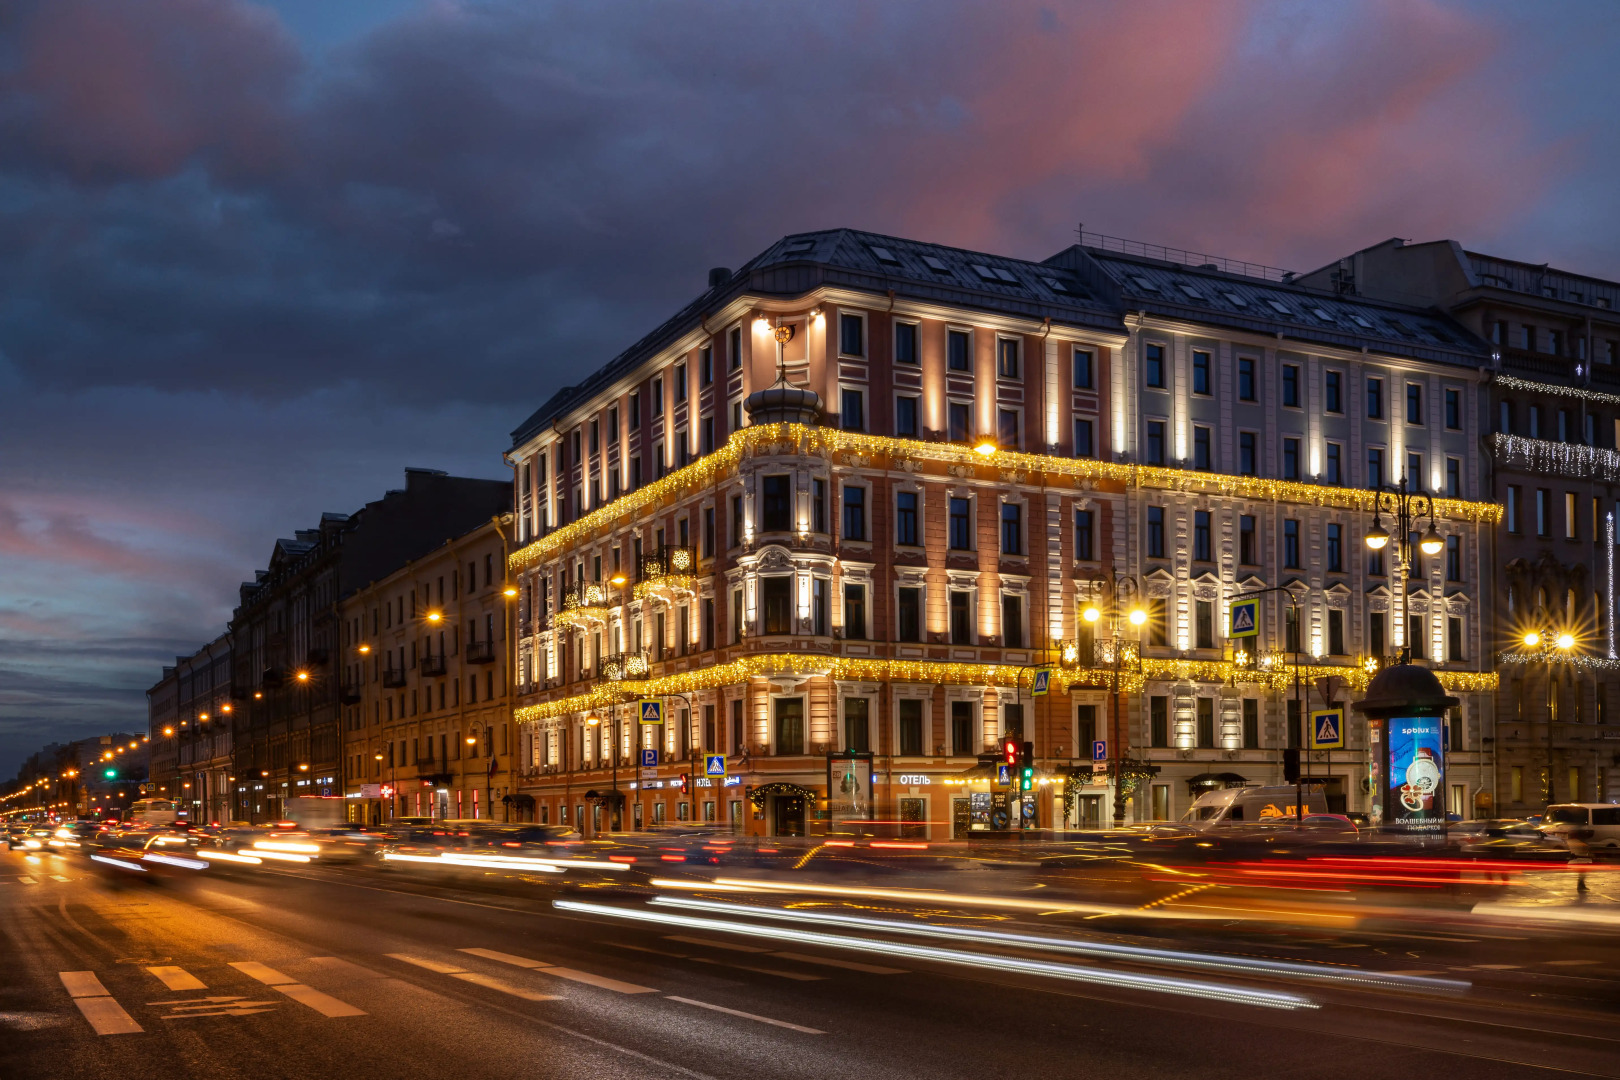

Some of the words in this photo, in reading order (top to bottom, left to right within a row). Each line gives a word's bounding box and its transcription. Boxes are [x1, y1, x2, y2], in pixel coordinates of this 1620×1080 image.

[1402, 727, 1429, 735] spblux
[696, 778, 712, 787] HOTEL
[900, 775, 931, 785] ОТЕЛЬ
[1395, 817, 1437, 825] ВОЛШЕБНЫЙ
